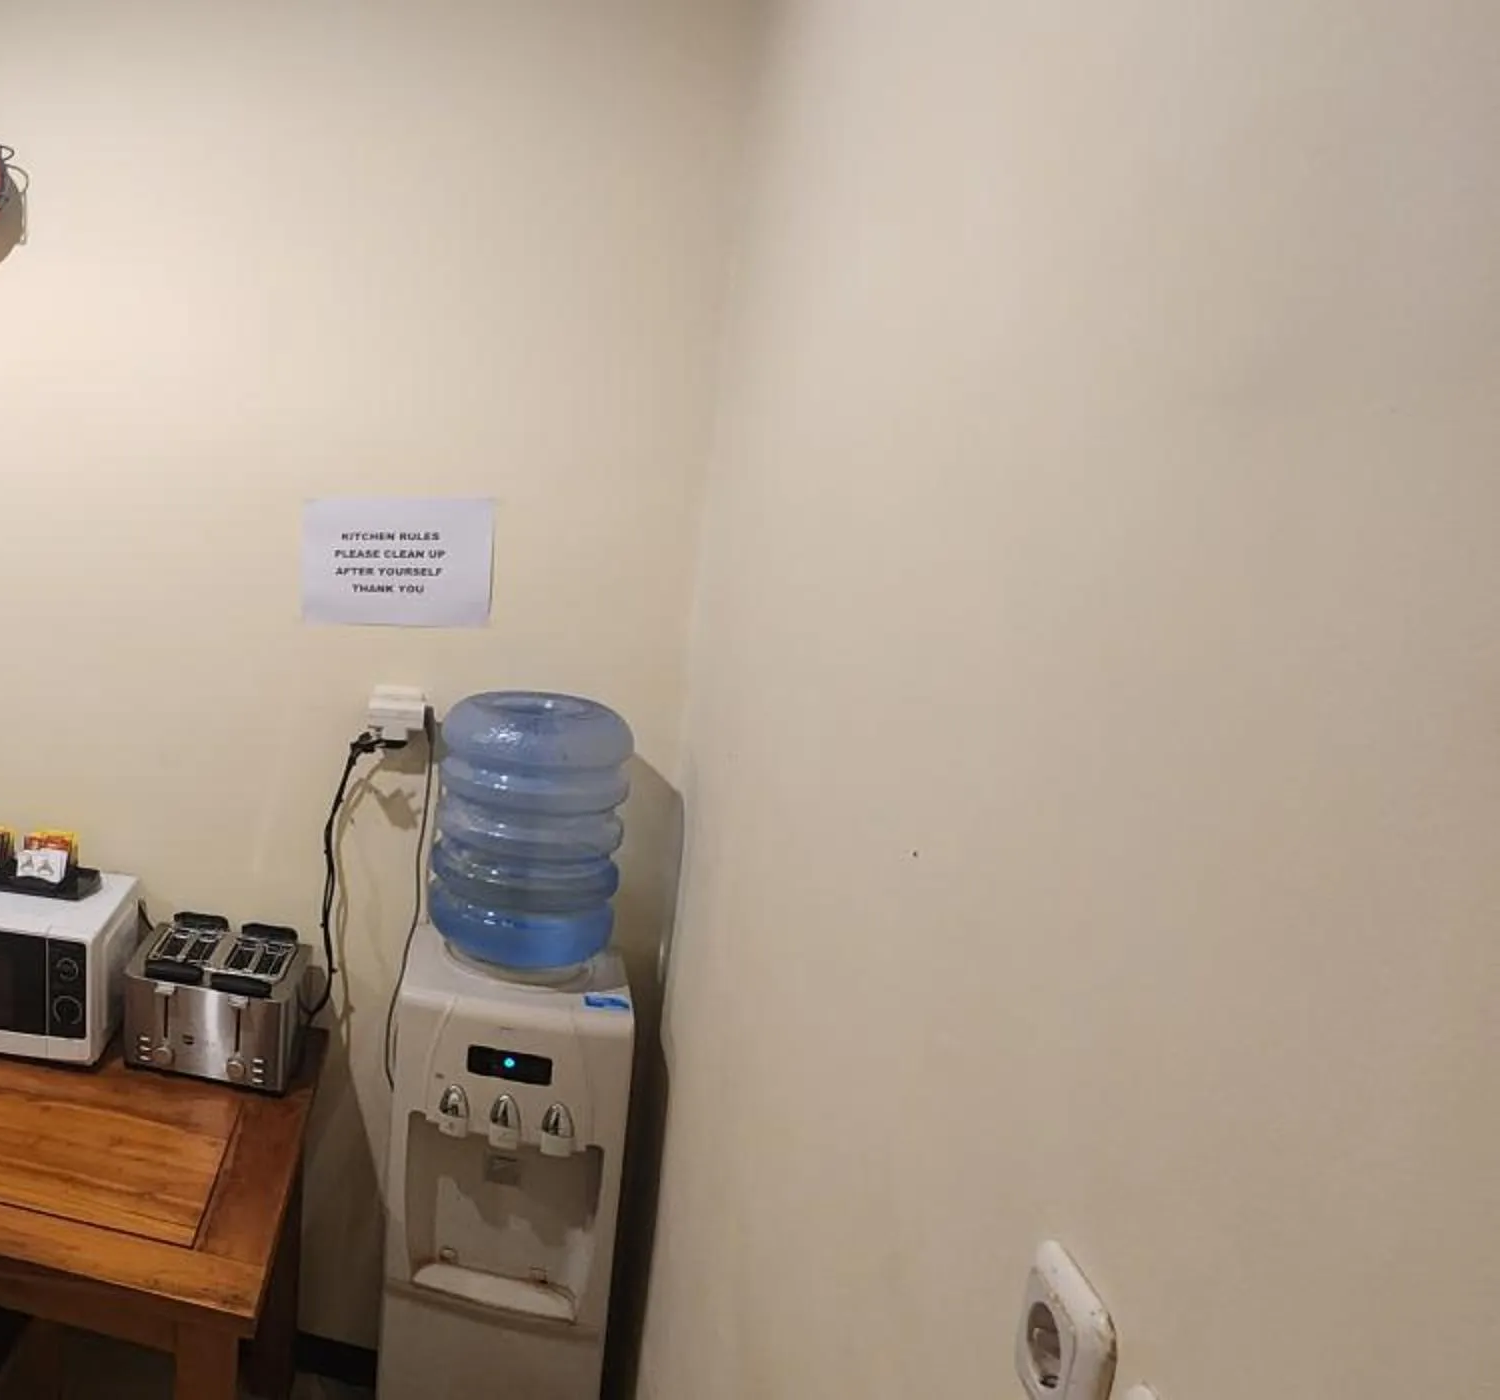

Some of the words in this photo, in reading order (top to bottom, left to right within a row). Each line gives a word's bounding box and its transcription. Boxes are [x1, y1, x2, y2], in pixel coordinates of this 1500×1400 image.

[341, 531, 395, 541] KITCHEN
[399, 532, 440, 541] RULES
[334, 549, 380, 559] PLEASE
[383, 550, 425, 559] CLEAN
[429, 550, 446, 559] UP
[335, 567, 375, 577] AFTER
[378, 567, 443, 577] YOURSELF
[352, 584, 394, 593] THANK
[399, 585, 425, 593] YOU
